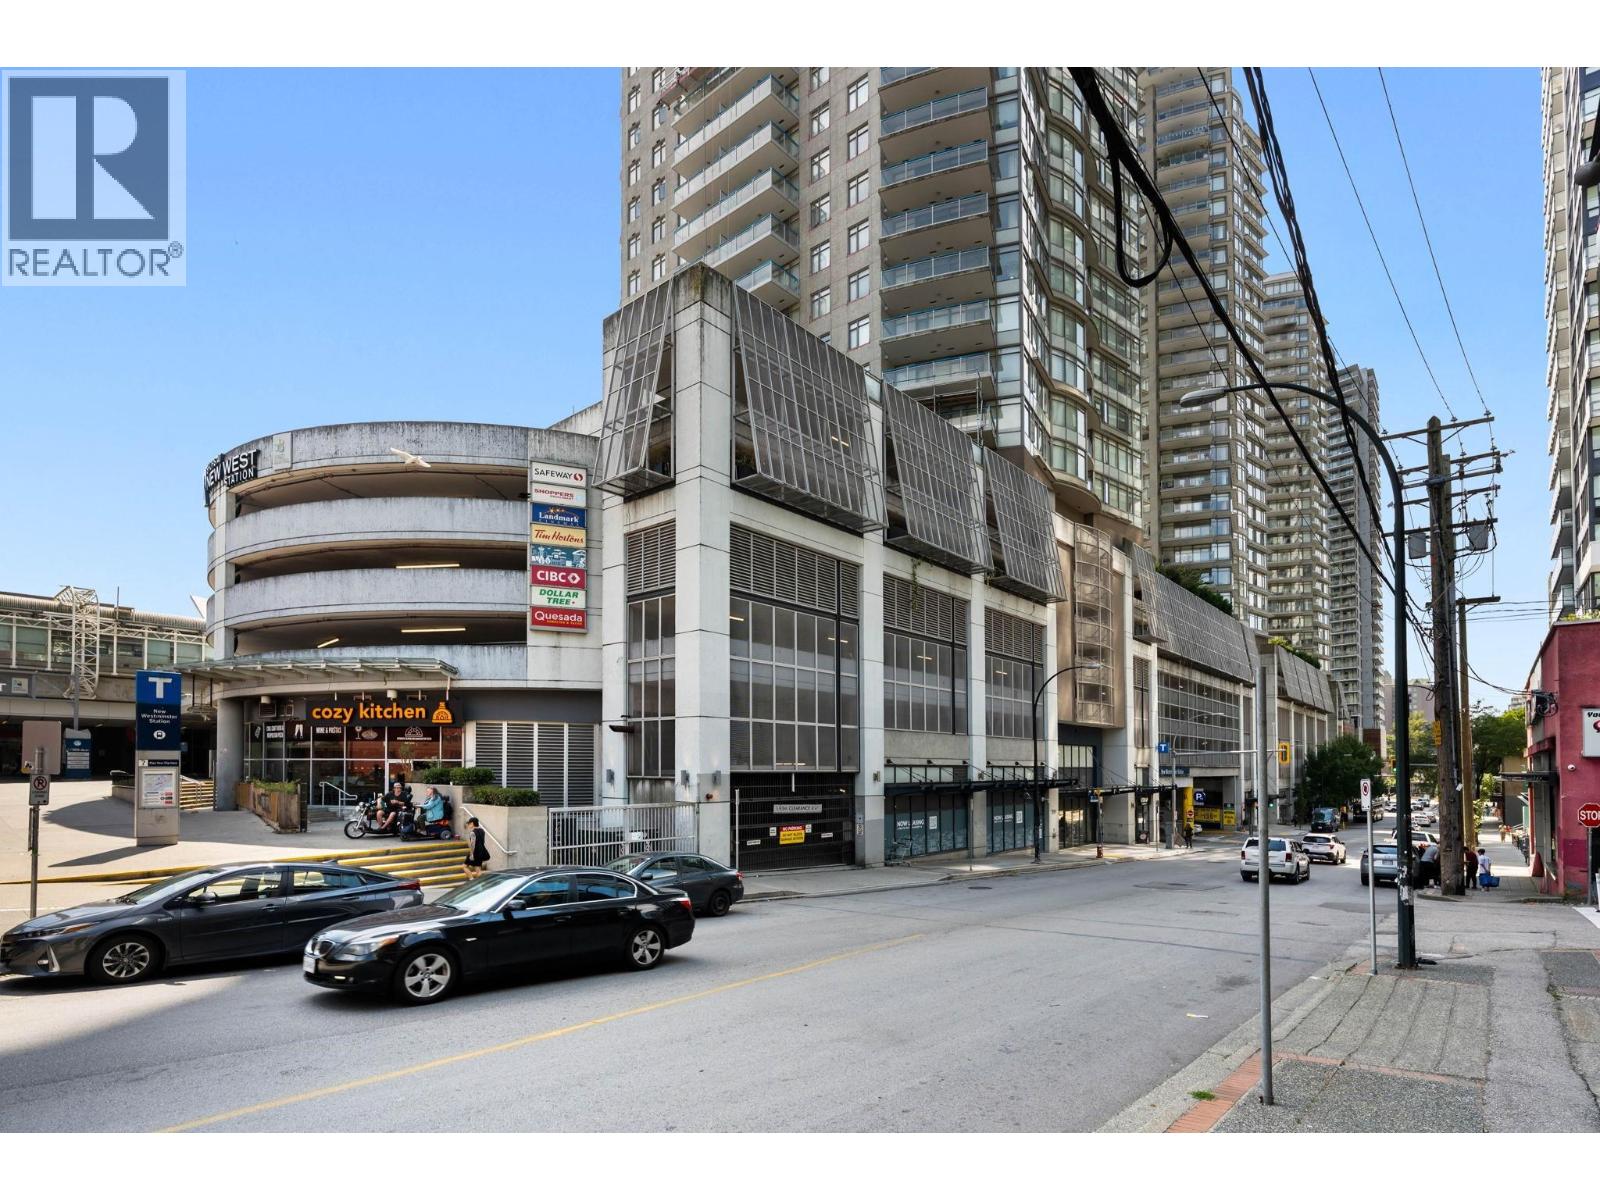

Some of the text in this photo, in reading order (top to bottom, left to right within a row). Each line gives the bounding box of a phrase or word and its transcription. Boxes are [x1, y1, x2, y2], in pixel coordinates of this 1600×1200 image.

[222, 449, 257, 475] WEST
[224, 466, 254, 485] STATION
[534, 467, 573, 479] SAFEWAY
[534, 488, 574, 498] SHOPPERS
[539, 511, 579, 523] Landmark
[534, 529, 584, 544] Tim Hortons
[536, 570, 567, 583] CIBC
[539, 588, 579, 599] DOLLAR
[546, 597, 571, 606] TREE
[534, 610, 583, 622] Quesada
[148, 676, 173, 699] T
[312, 702, 426, 724] cozy kitchen
[1159, 743, 1167, 751] T
